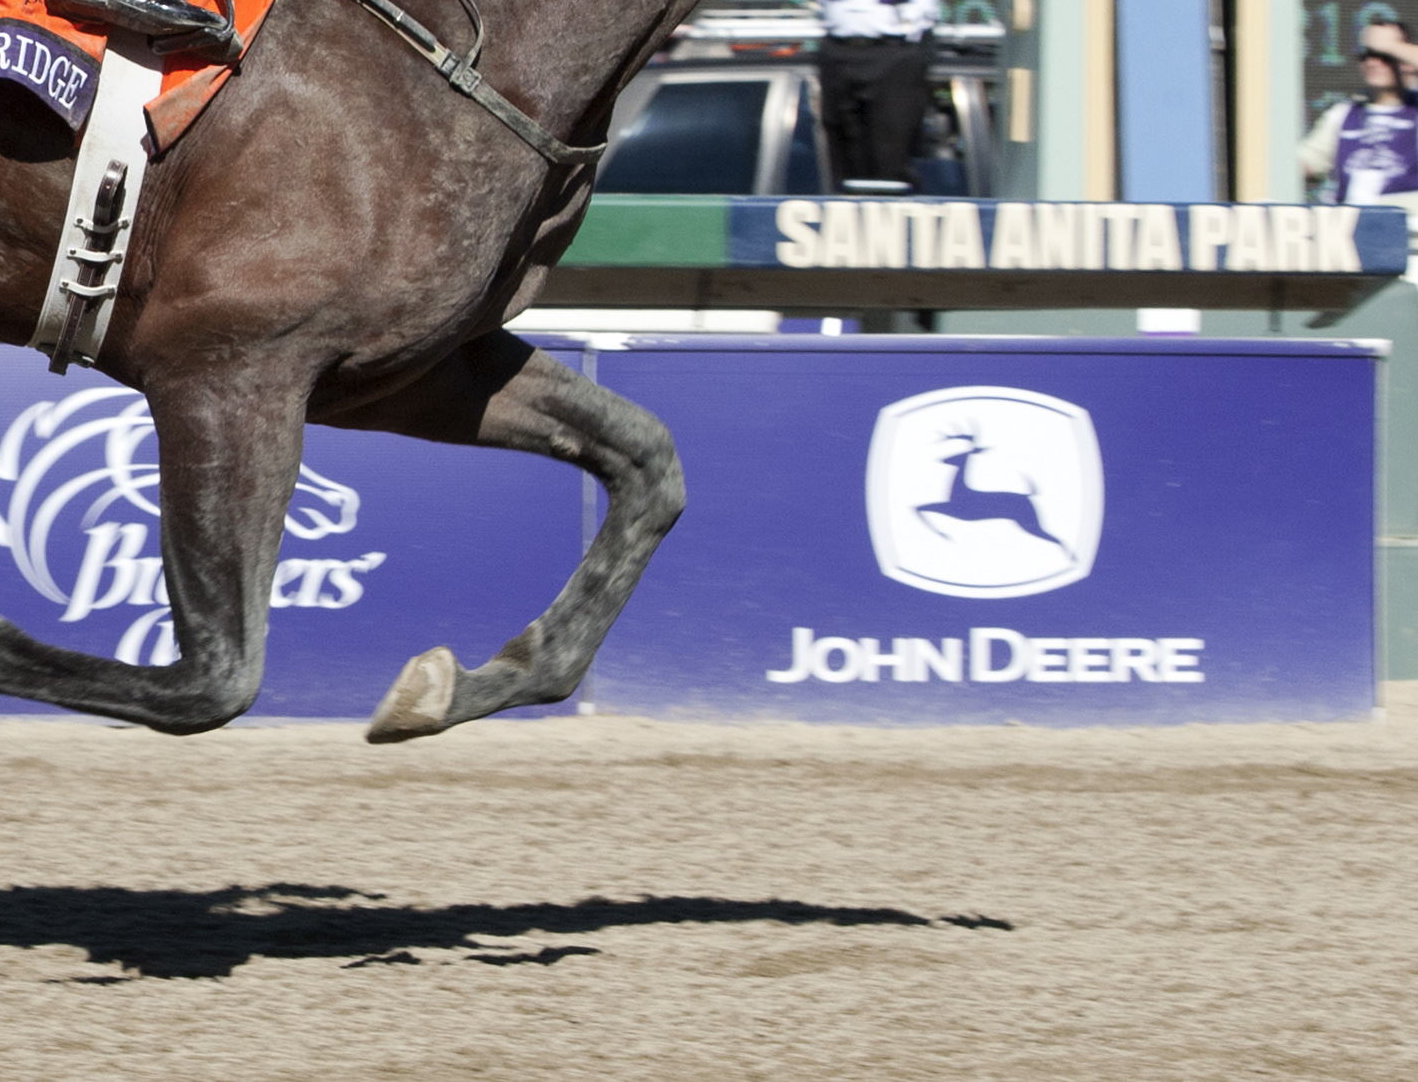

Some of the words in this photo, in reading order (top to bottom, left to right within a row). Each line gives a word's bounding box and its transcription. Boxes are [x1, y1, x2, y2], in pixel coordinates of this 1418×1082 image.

[776, 200, 985, 269] SANTA
[988, 201, 1184, 272] ANITA
[1188, 204, 1363, 273] PARK
